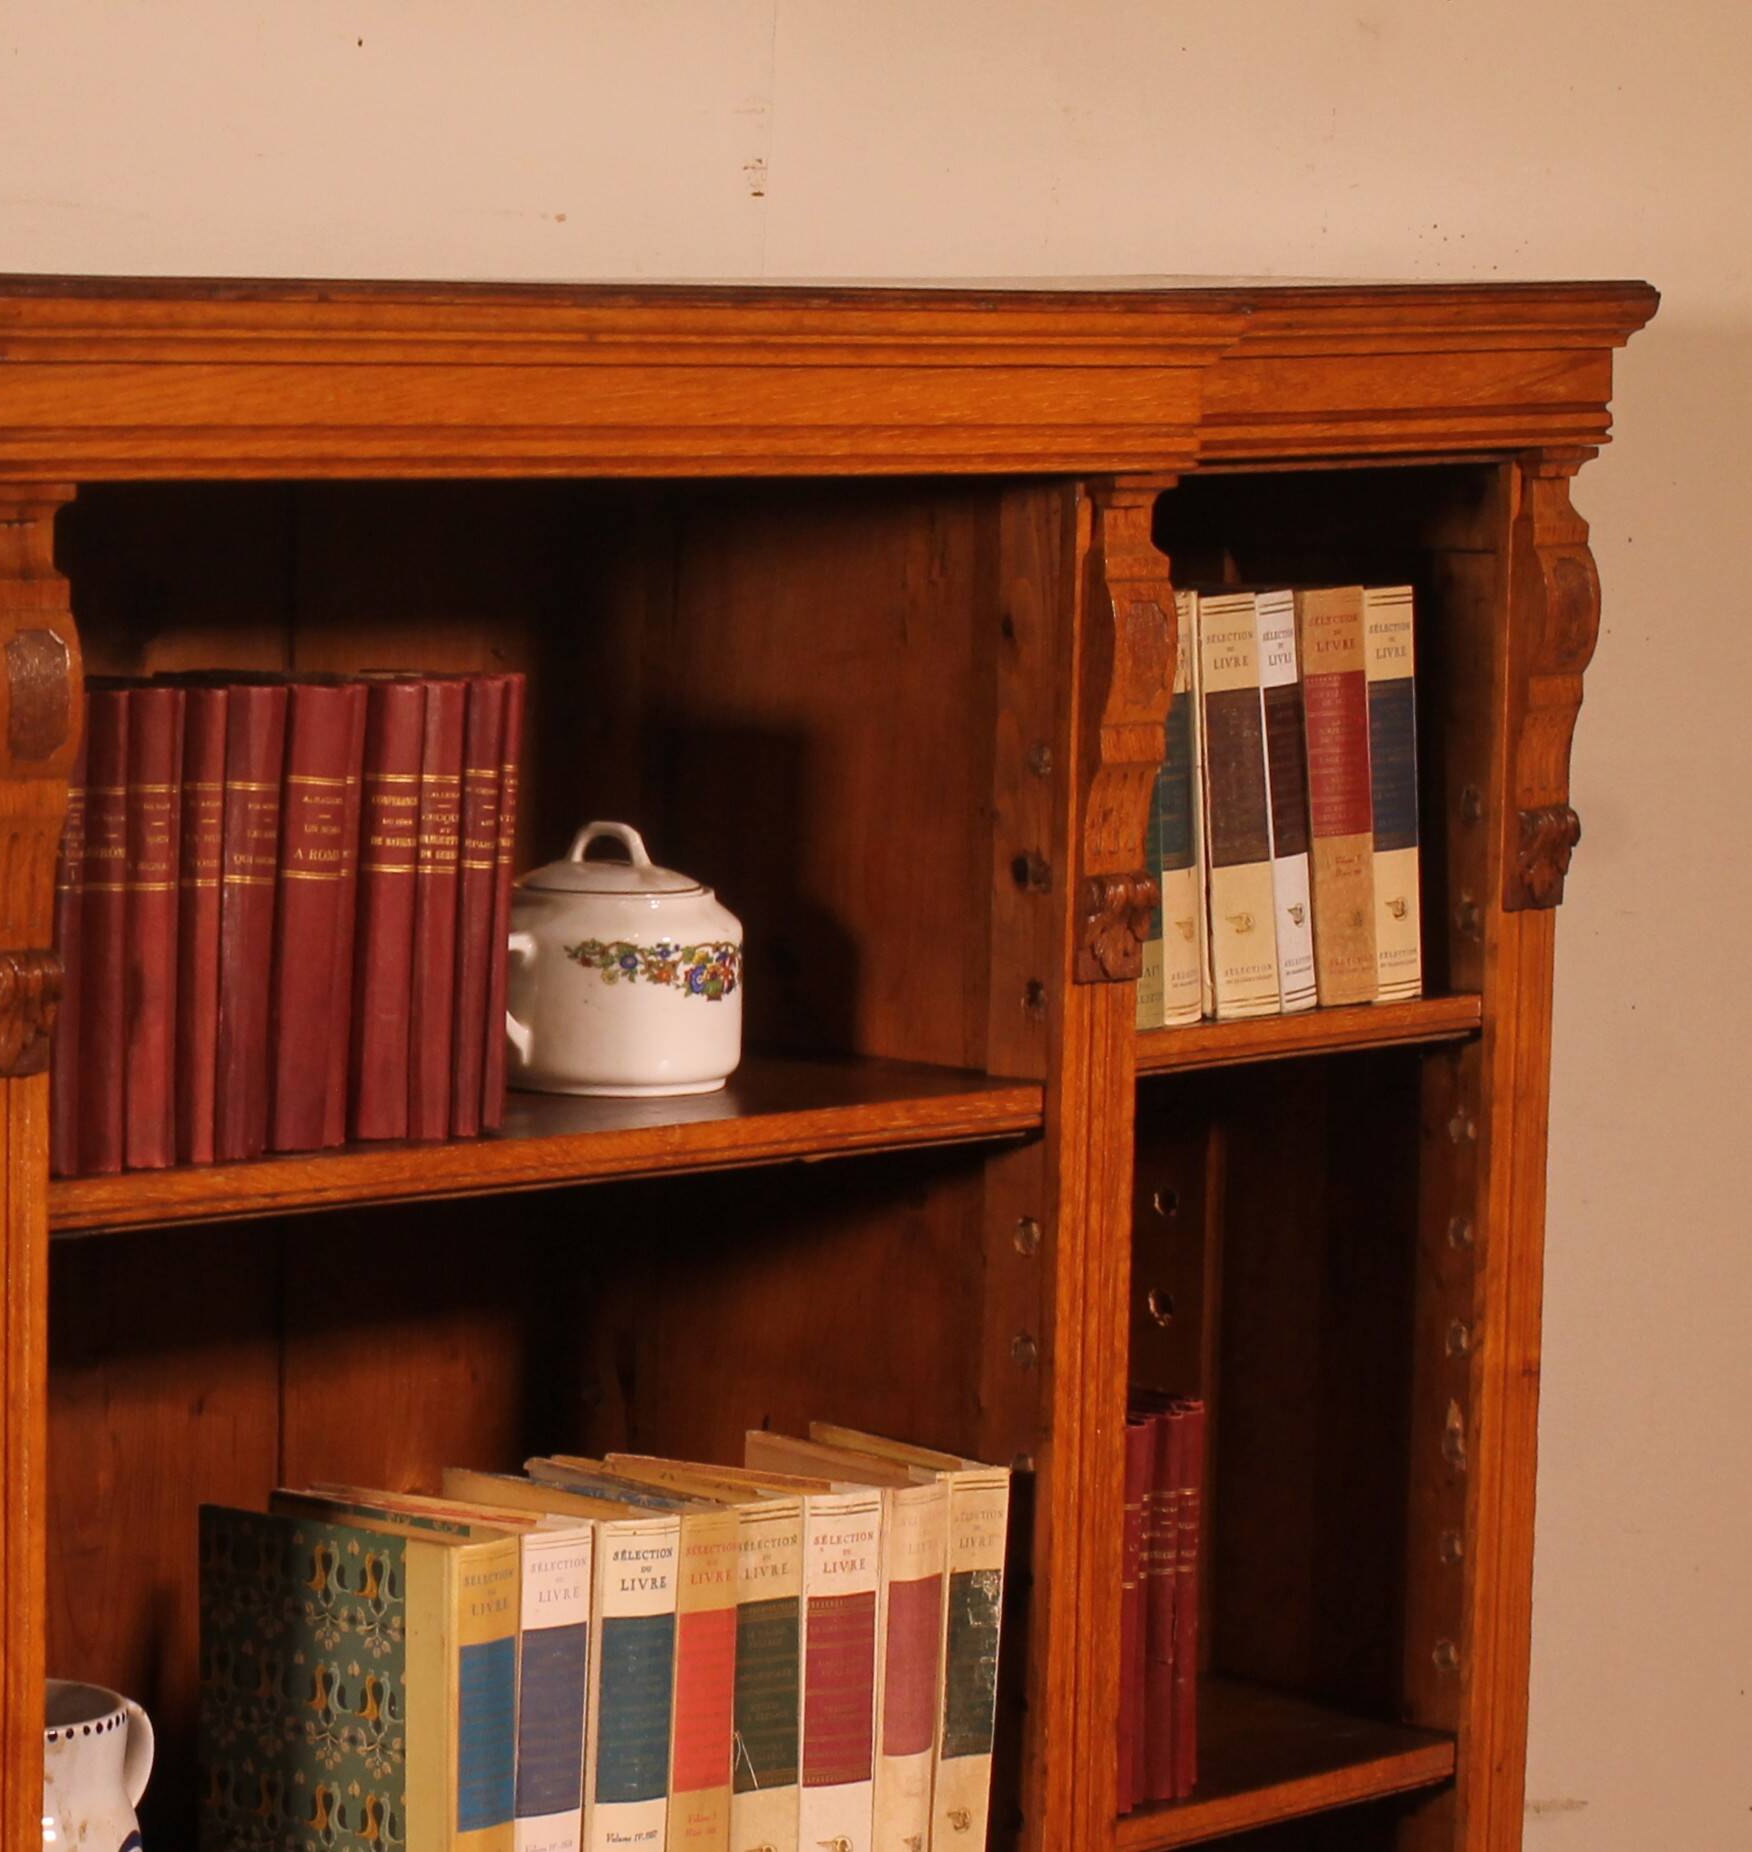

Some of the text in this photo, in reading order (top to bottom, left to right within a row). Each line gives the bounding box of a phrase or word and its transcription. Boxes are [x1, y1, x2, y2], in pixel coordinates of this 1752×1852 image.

[1315, 638, 1356, 653] LIVRE
[1375, 645, 1407, 660] LIVRE
[1213, 655, 1249, 670] LIVRE
[813, 1530, 875, 1546] SÉLECTION
[612, 1546, 674, 1561] SÉLECTION
[744, 1562, 789, 1580] LIVRE
[822, 1557, 866, 1574] LIVRE
[620, 1575, 668, 1592] LIVRE
[690, 1568, 733, 1586] LIVRE
[537, 1585, 581, 1604] LIVRE
